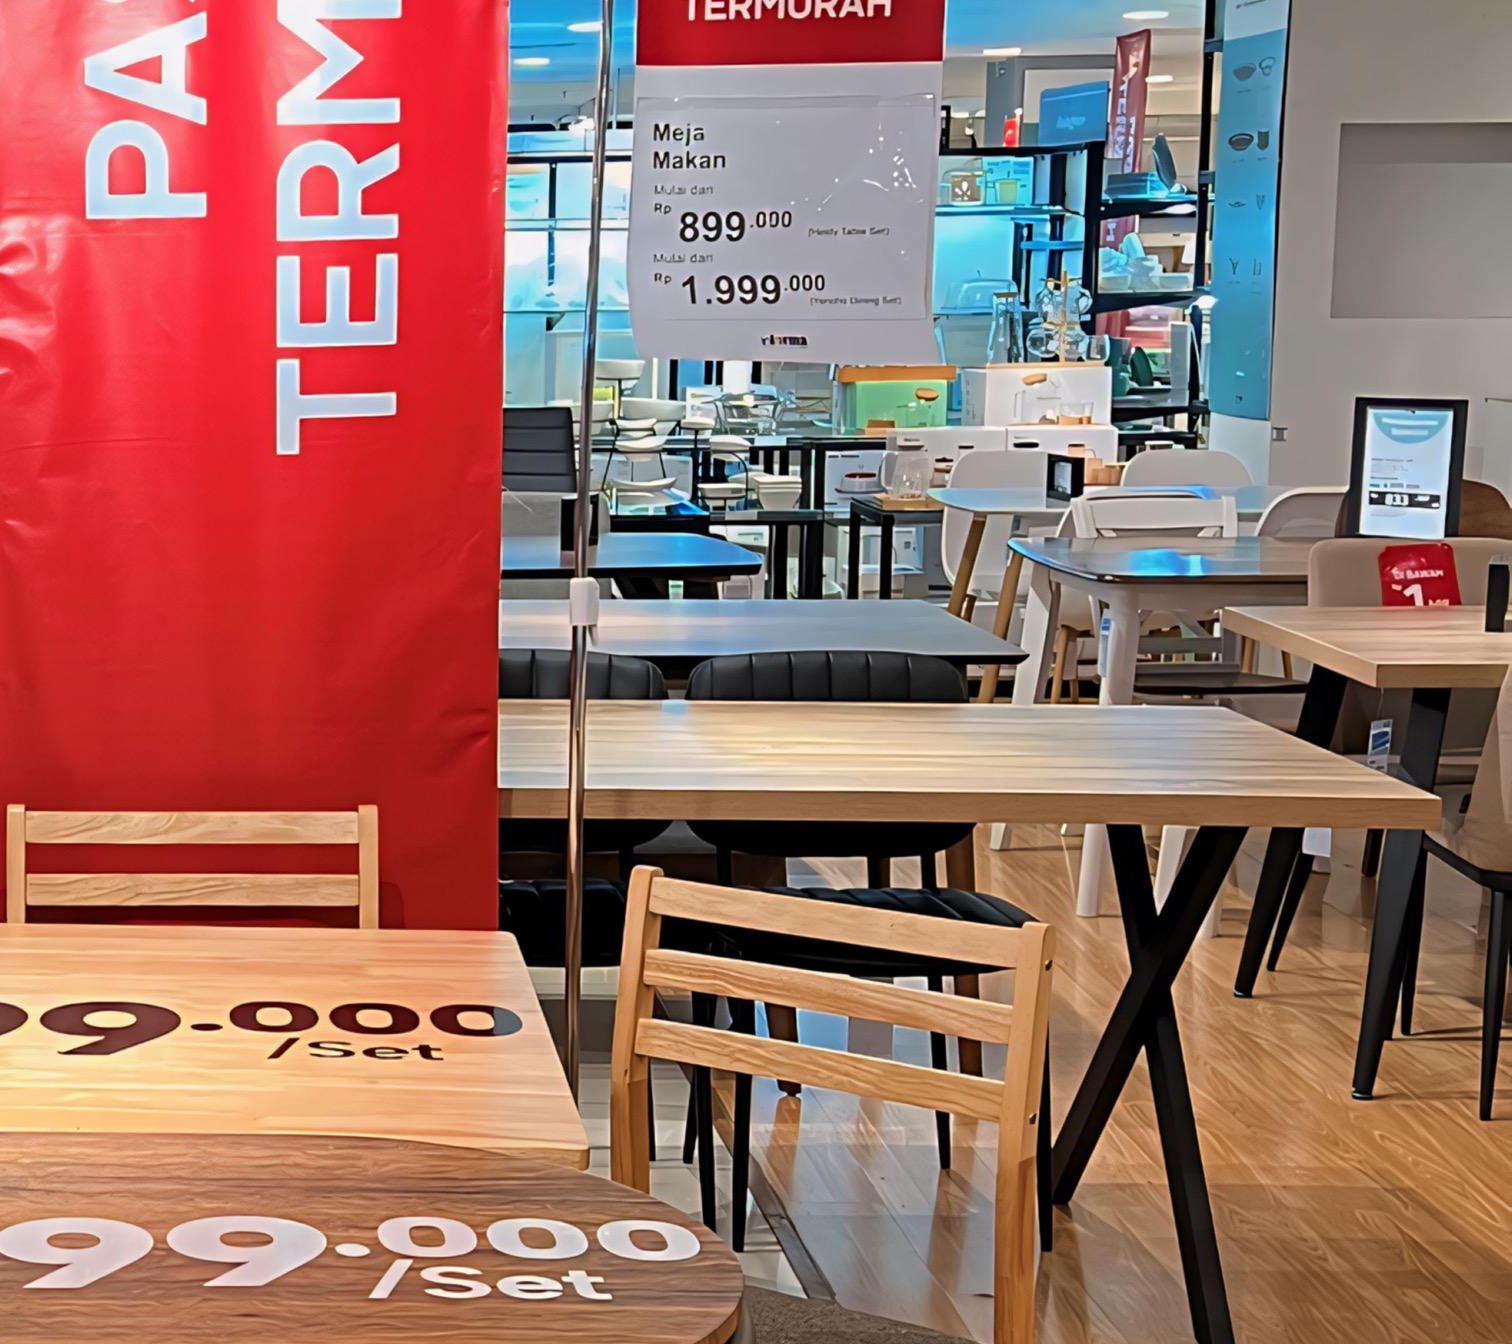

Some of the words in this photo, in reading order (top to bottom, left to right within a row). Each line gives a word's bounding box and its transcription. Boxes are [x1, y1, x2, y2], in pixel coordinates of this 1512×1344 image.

[653, 123, 705, 146] Meja
[653, 151, 727, 170] Makan
[654, 202, 672, 215] Rp
[654, 272, 672, 285] Rp
[266, 1037, 444, 1061] /Set
[368, 1258, 614, 1301] /Set
